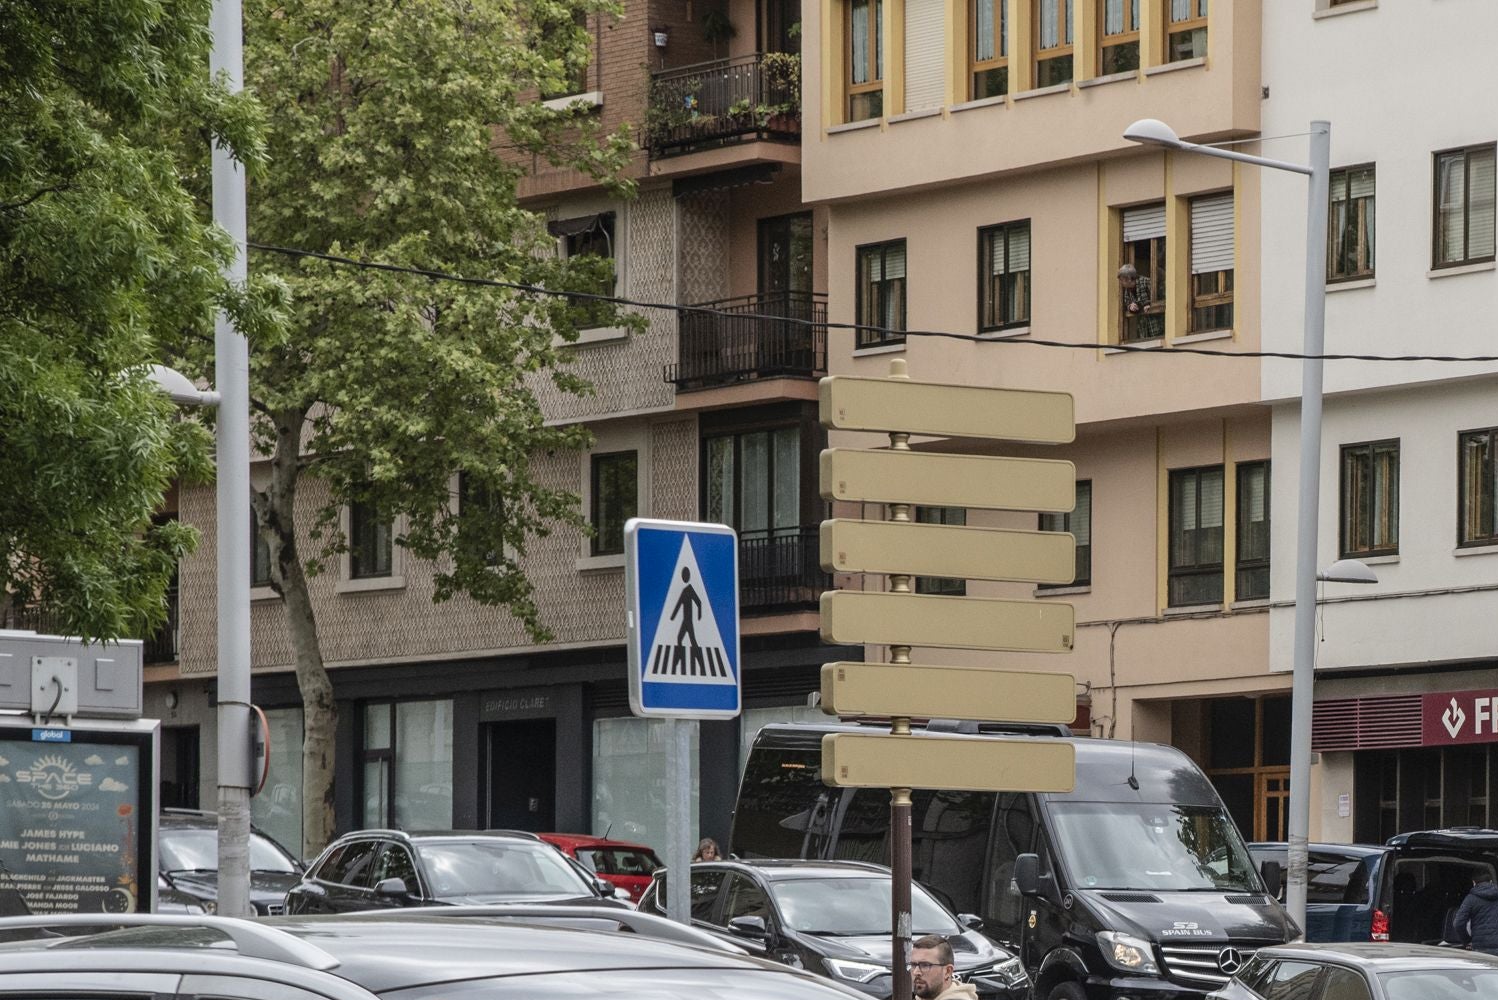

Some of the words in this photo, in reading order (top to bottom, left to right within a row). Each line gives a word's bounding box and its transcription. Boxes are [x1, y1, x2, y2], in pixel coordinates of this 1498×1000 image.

[40, 730, 63, 740] global
[16, 770, 92, 785] SPACE
[54, 802, 80, 810] MAYO
[21, 829, 57, 839] JAMES
[58, 830, 85, 840] HYPE
[21, 842, 57, 850] JONES
[71, 843, 119, 852] LUCIANO
[26, 854, 80, 863] MATHAME
[45, 893, 79, 901] FAJARDO
[26, 901, 54, 909] MANDA
